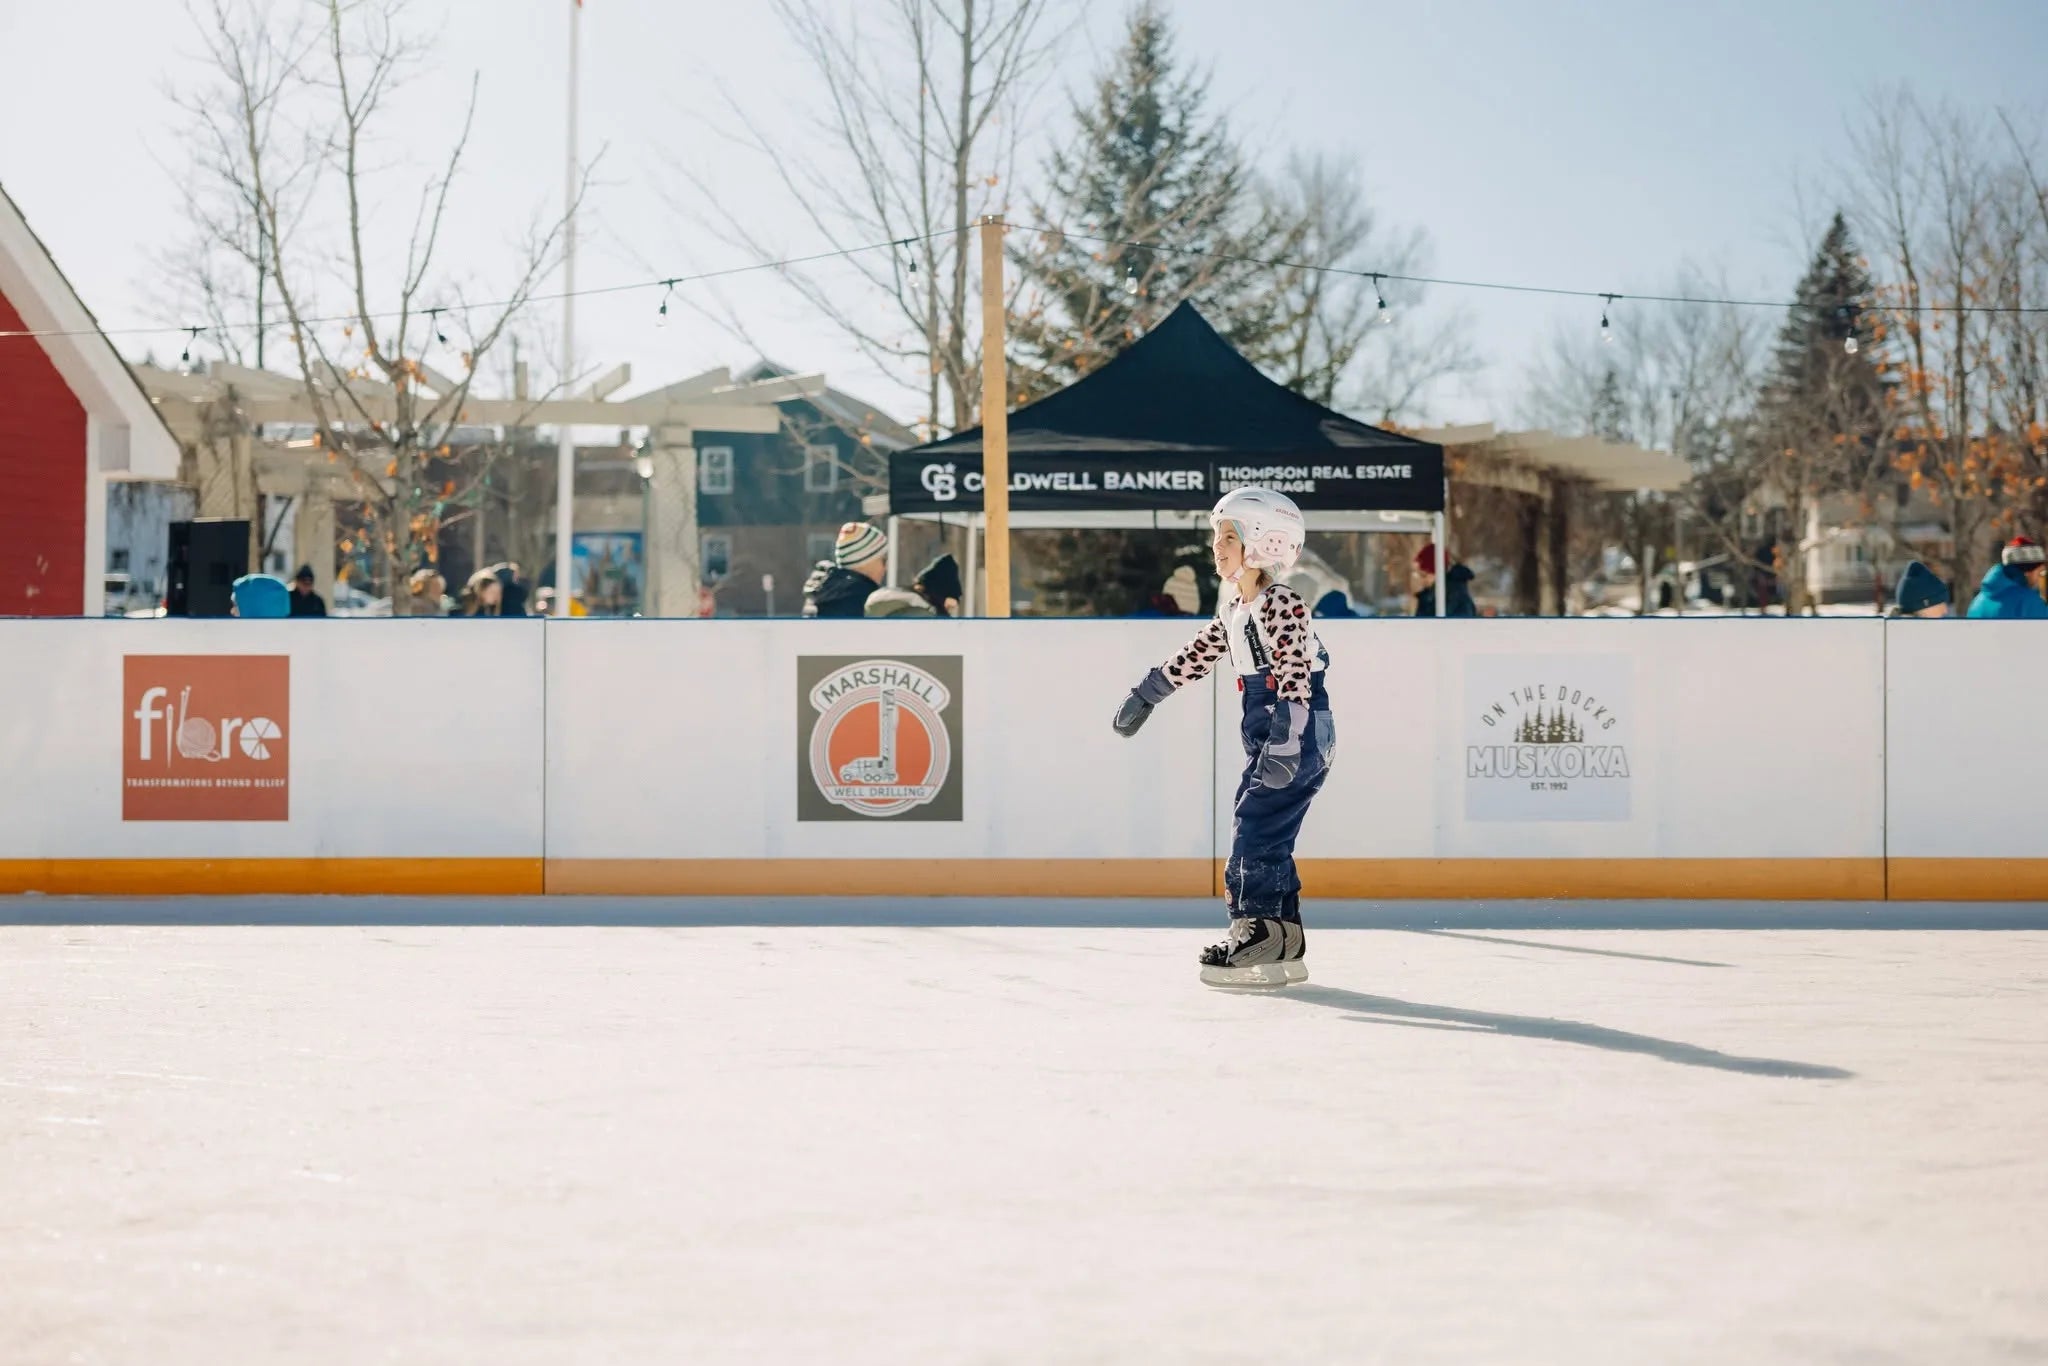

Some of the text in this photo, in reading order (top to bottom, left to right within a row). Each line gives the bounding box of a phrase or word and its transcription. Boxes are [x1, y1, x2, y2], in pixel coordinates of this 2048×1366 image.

[963, 471, 1204, 491] CDWELL BANKER
[1219, 465, 1412, 480] THOMPSON REAL ESTATE
[821, 668, 933, 704] MARSHALL
[1481, 684, 1616, 730] ON THE DOCKS
[133, 685, 283, 769] fibre
[1467, 745, 1630, 779] MUSKOKA
[126, 778, 286, 788] TRANSFORMATIONS BEYOND BELIEF
[834, 787, 925, 797] WELL DRILLING
[1530, 782, 1568, 791] EST. 1992
